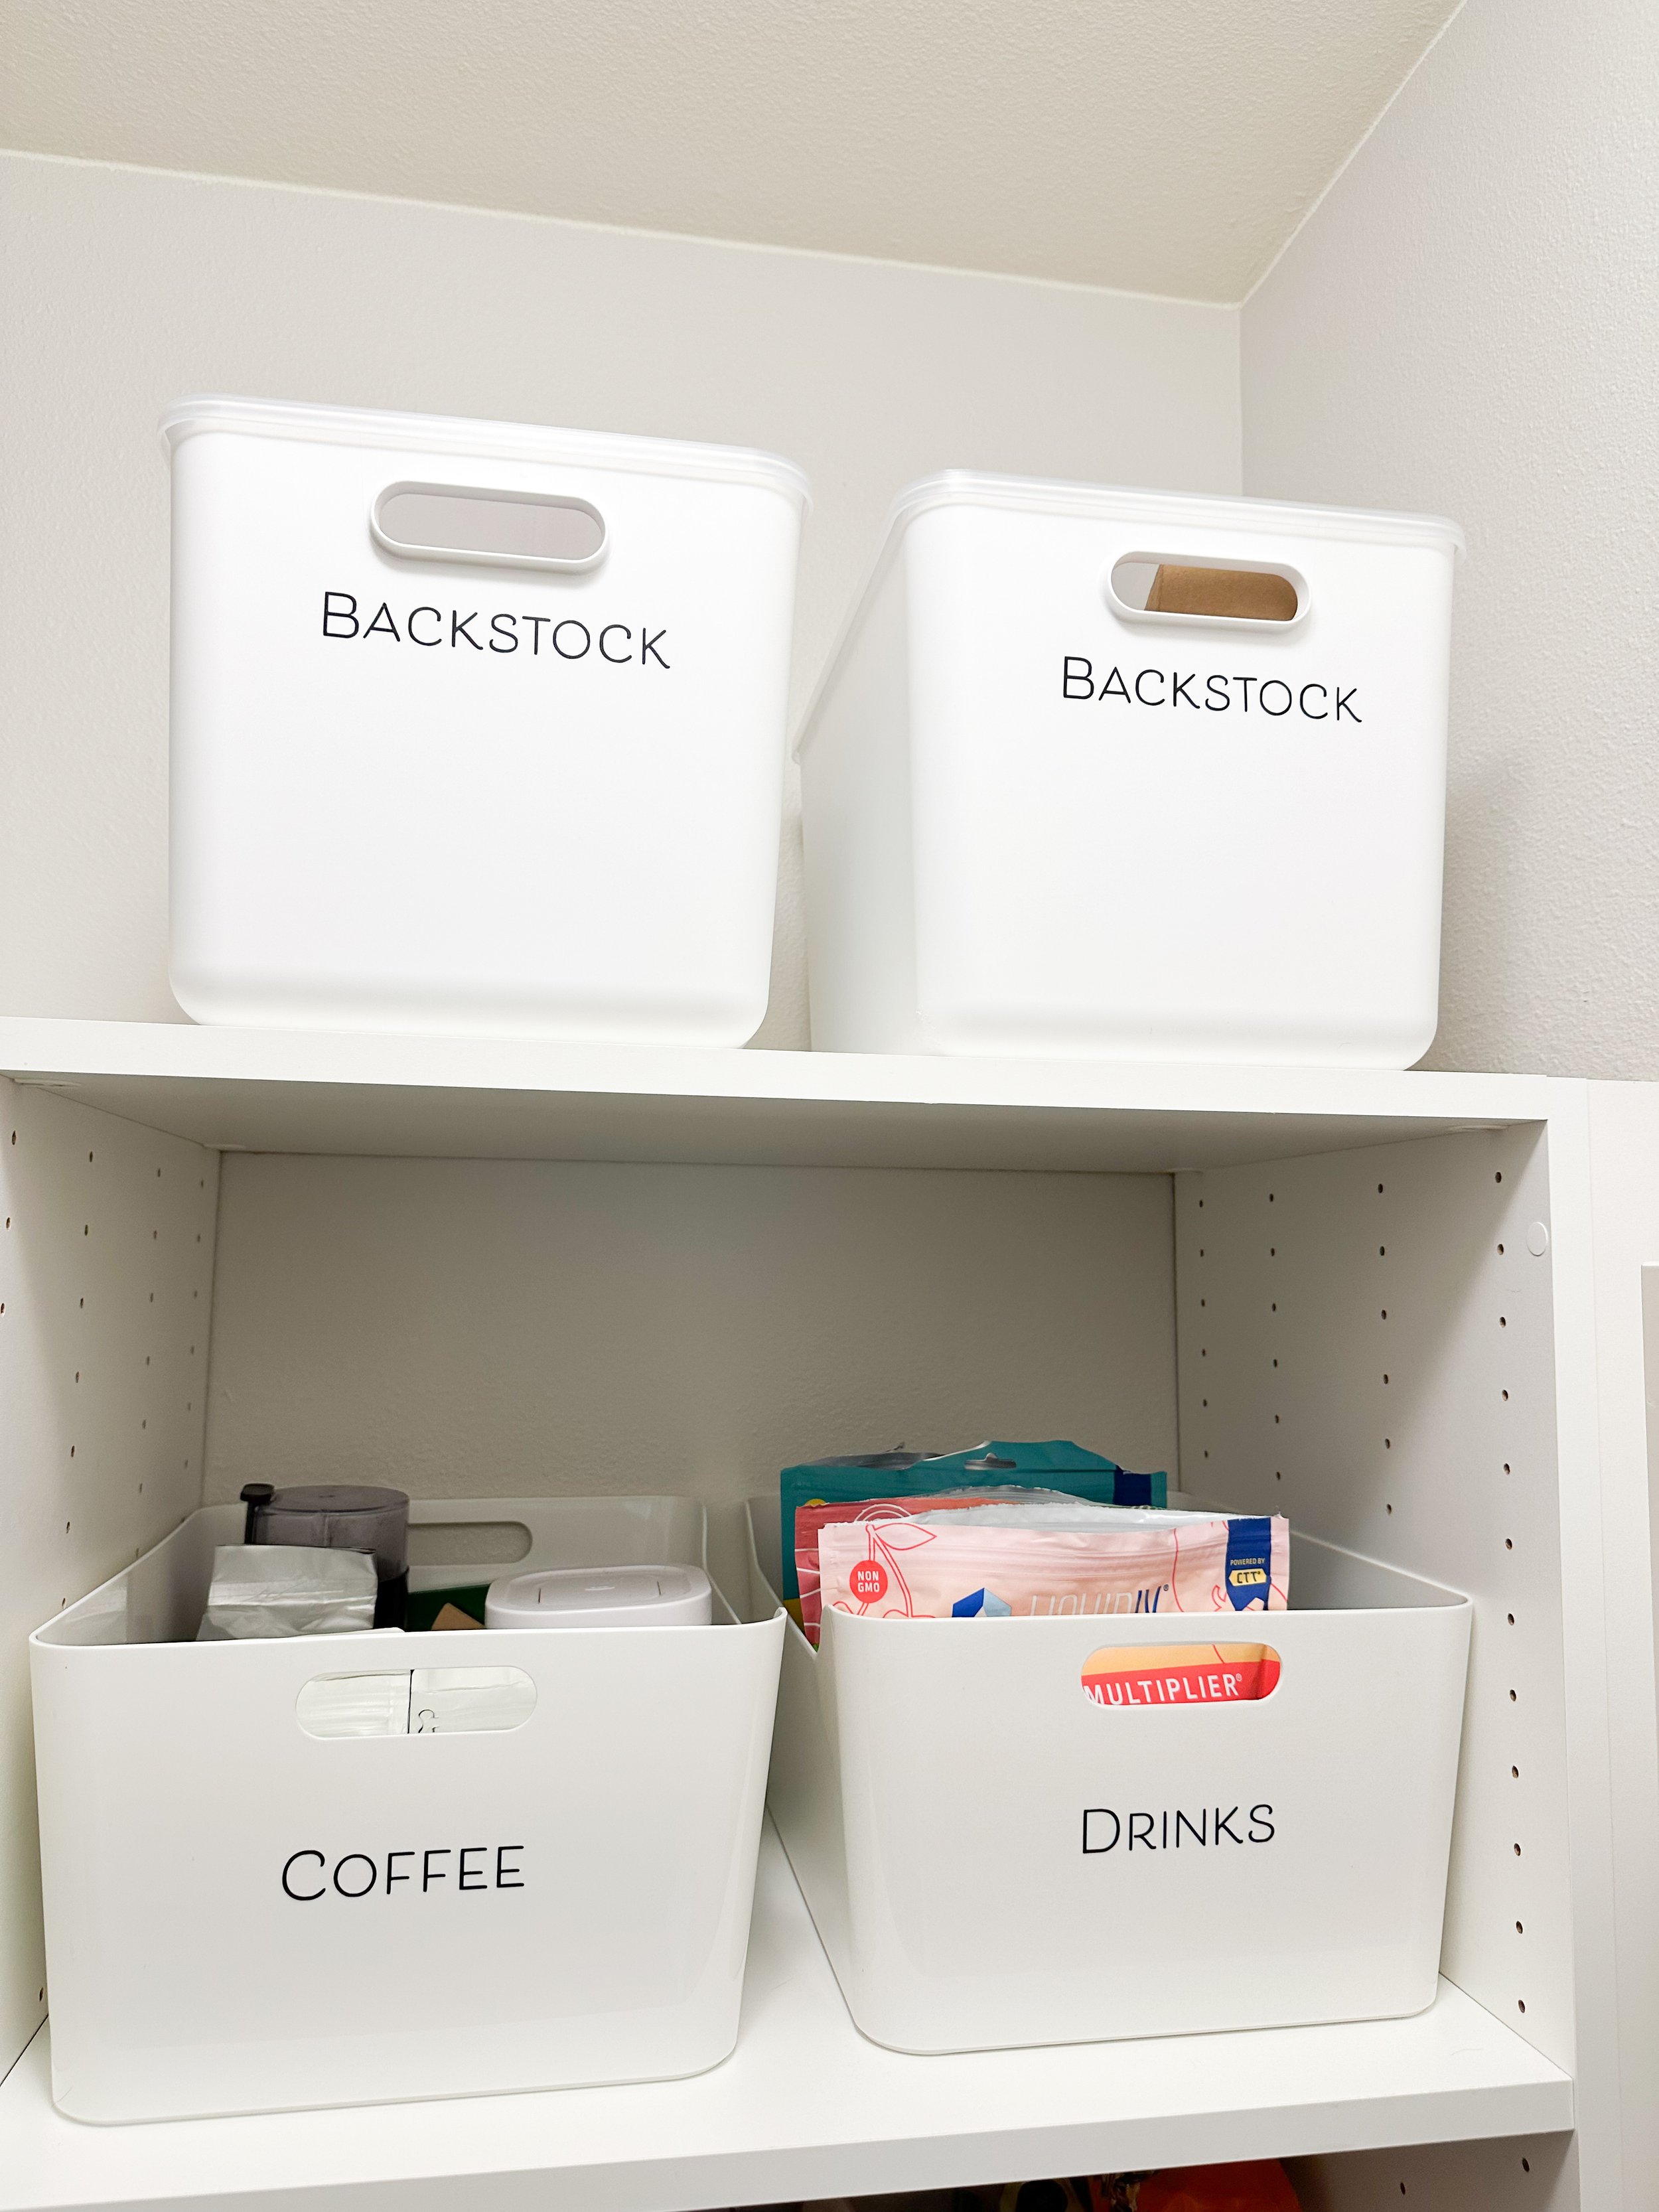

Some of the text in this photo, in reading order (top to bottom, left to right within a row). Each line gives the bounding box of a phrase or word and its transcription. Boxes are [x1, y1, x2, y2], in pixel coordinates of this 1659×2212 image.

[323, 591, 670, 669] BACKSTOCK
[1062, 656, 1362, 723] BACKSTOCK
[857, 1570, 879, 1581] NON
[857, 1582, 880, 1593] GMO
[1082, 1804, 1275, 1854] DRINKS
[281, 1845, 525, 1901] COFFEE
